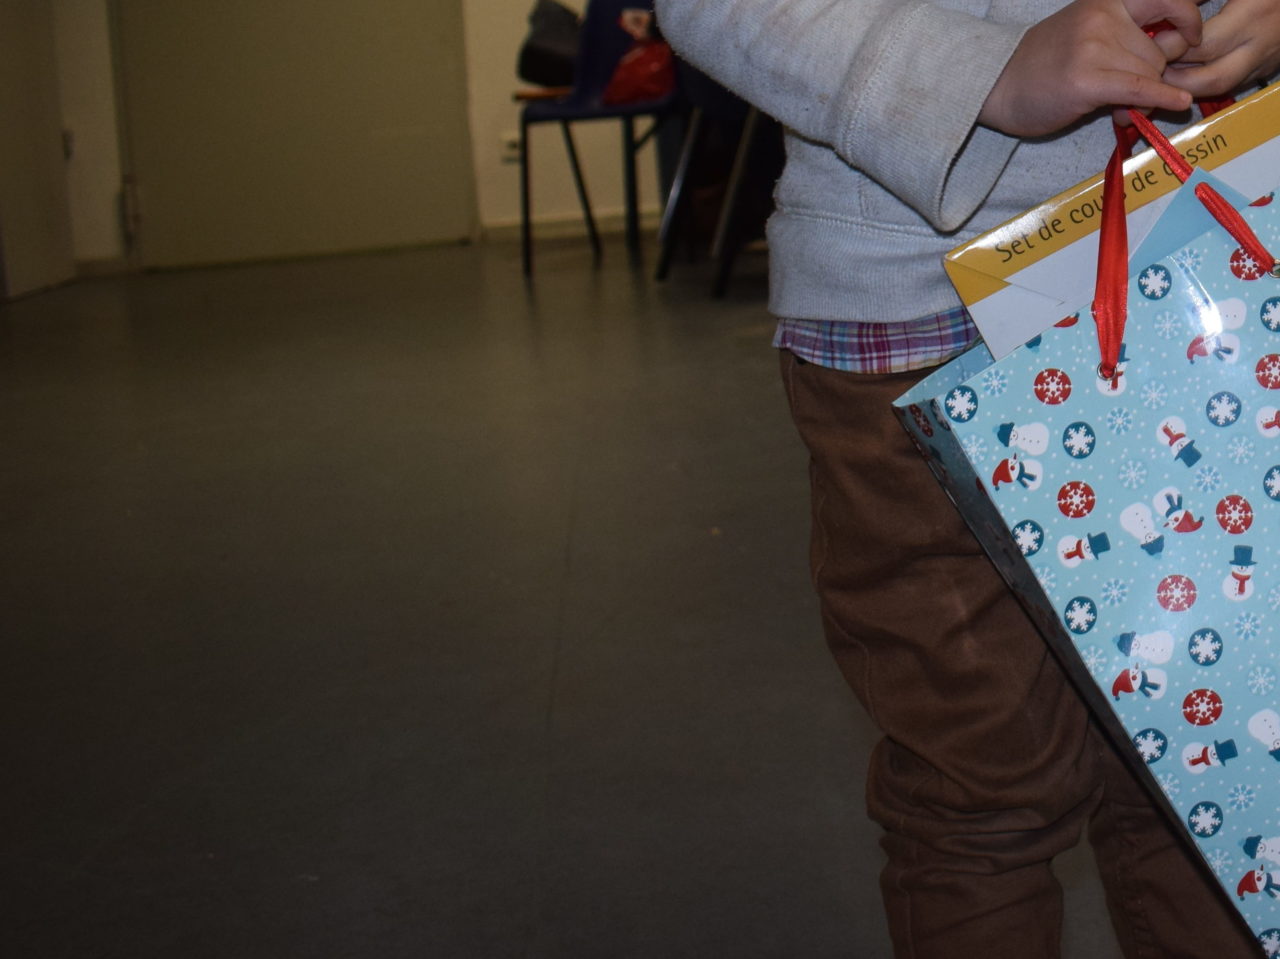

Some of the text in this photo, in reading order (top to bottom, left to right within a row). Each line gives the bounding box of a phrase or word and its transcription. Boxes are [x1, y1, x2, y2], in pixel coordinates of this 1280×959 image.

[995, 234, 1035, 263] Set
[1038, 218, 1066, 241] de
[1131, 170, 1158, 192] de
